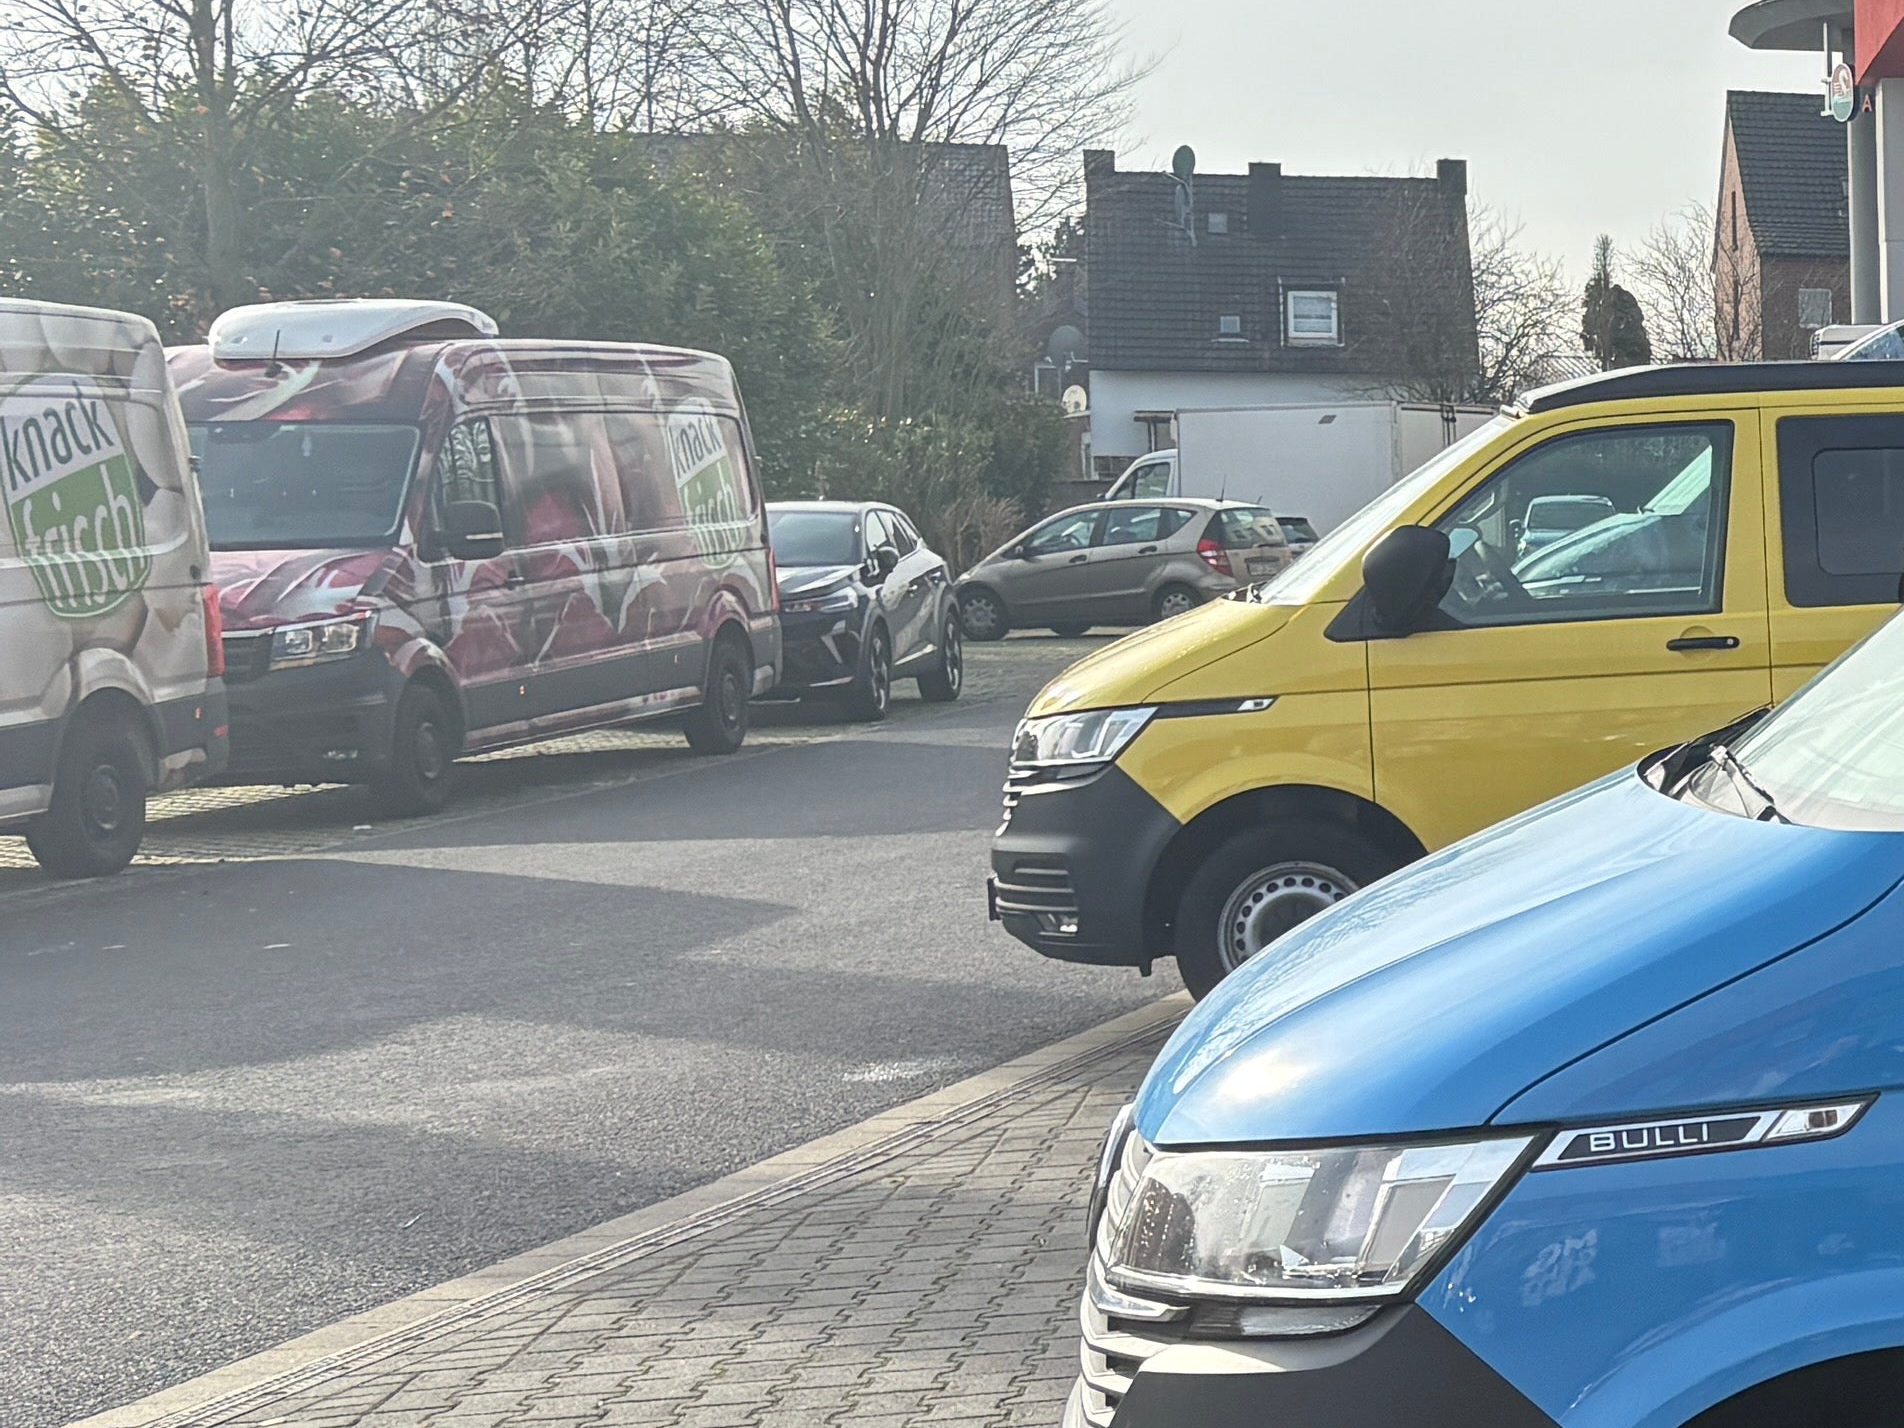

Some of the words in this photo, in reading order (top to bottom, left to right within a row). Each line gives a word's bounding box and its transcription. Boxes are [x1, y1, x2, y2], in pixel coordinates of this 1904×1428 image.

[1, 380, 115, 491] knack
[669, 408, 722, 479] knack
[22, 464, 146, 608] frisch
[1589, 1123, 1708, 1152] BULLI
